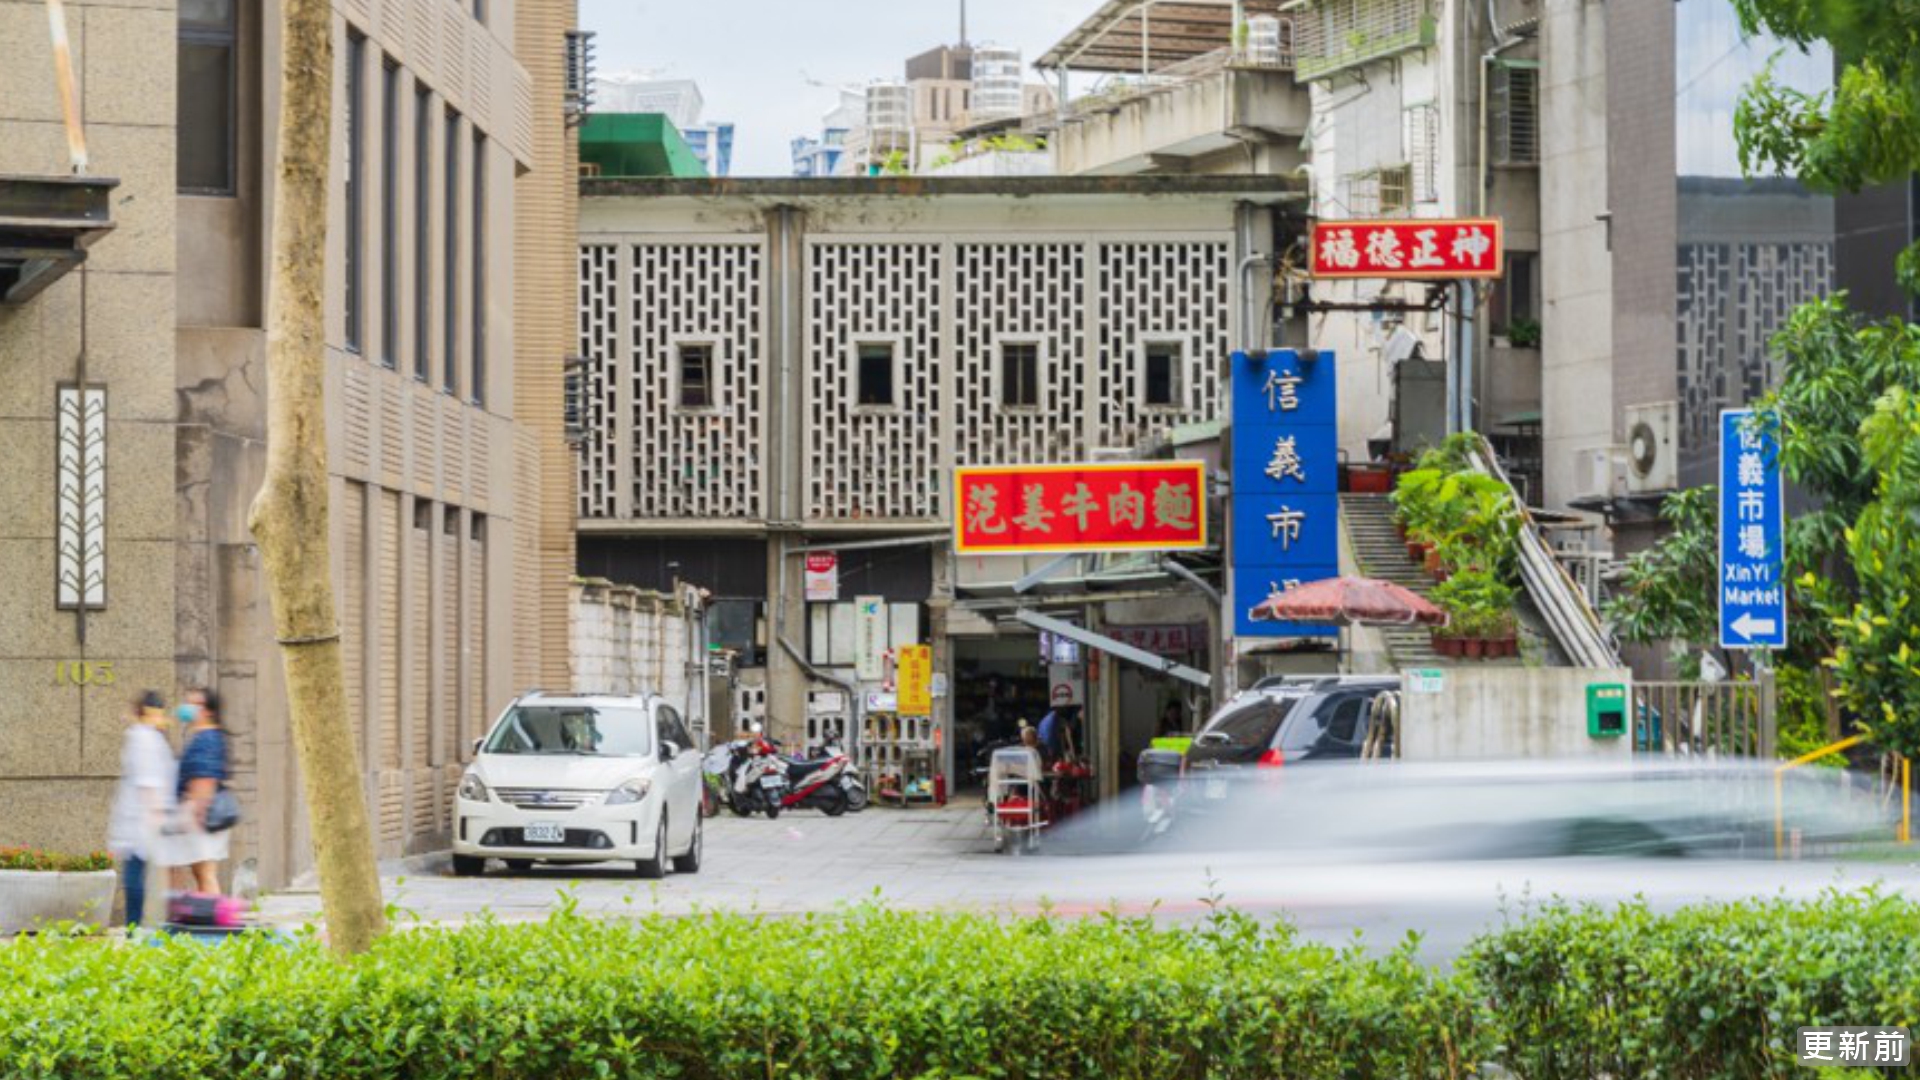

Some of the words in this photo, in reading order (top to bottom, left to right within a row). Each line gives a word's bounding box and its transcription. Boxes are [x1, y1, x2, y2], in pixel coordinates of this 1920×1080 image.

[1319, 226, 1491, 269] 福德正神
[967, 480, 1195, 534] 范姜牛肉麵
[1725, 586, 1780, 605] Market
[56, 661, 116, 687] 105
